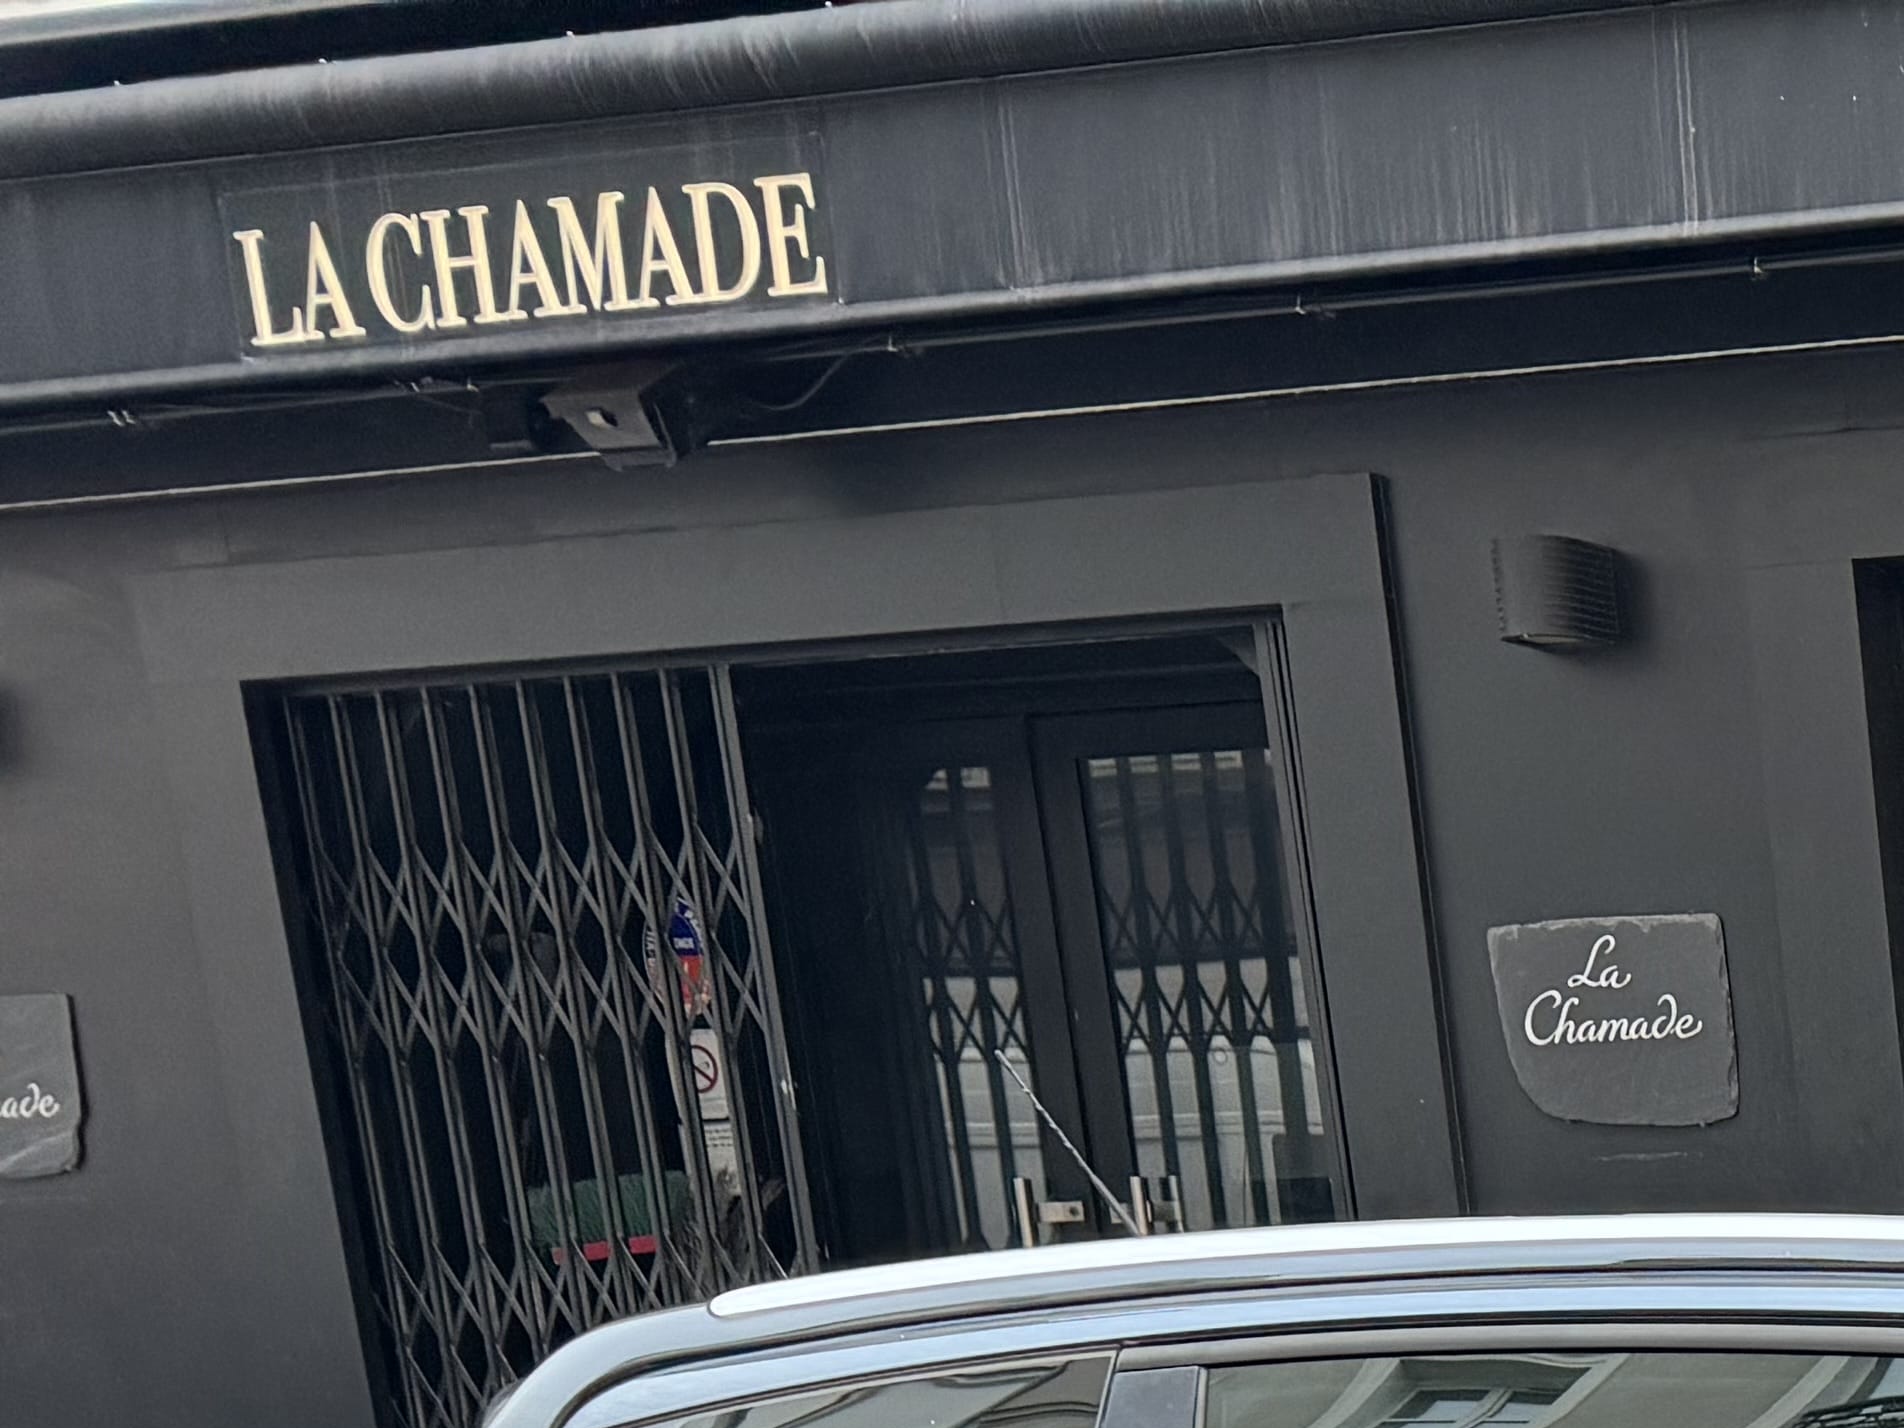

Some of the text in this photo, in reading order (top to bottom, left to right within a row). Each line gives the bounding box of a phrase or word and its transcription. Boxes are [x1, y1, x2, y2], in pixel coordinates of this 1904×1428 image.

[233, 172, 828, 347] LA CHAMADE
[1567, 934, 1633, 990] La
[1523, 988, 1704, 1047] Chamade
[0, 1081, 61, 1121] ade
